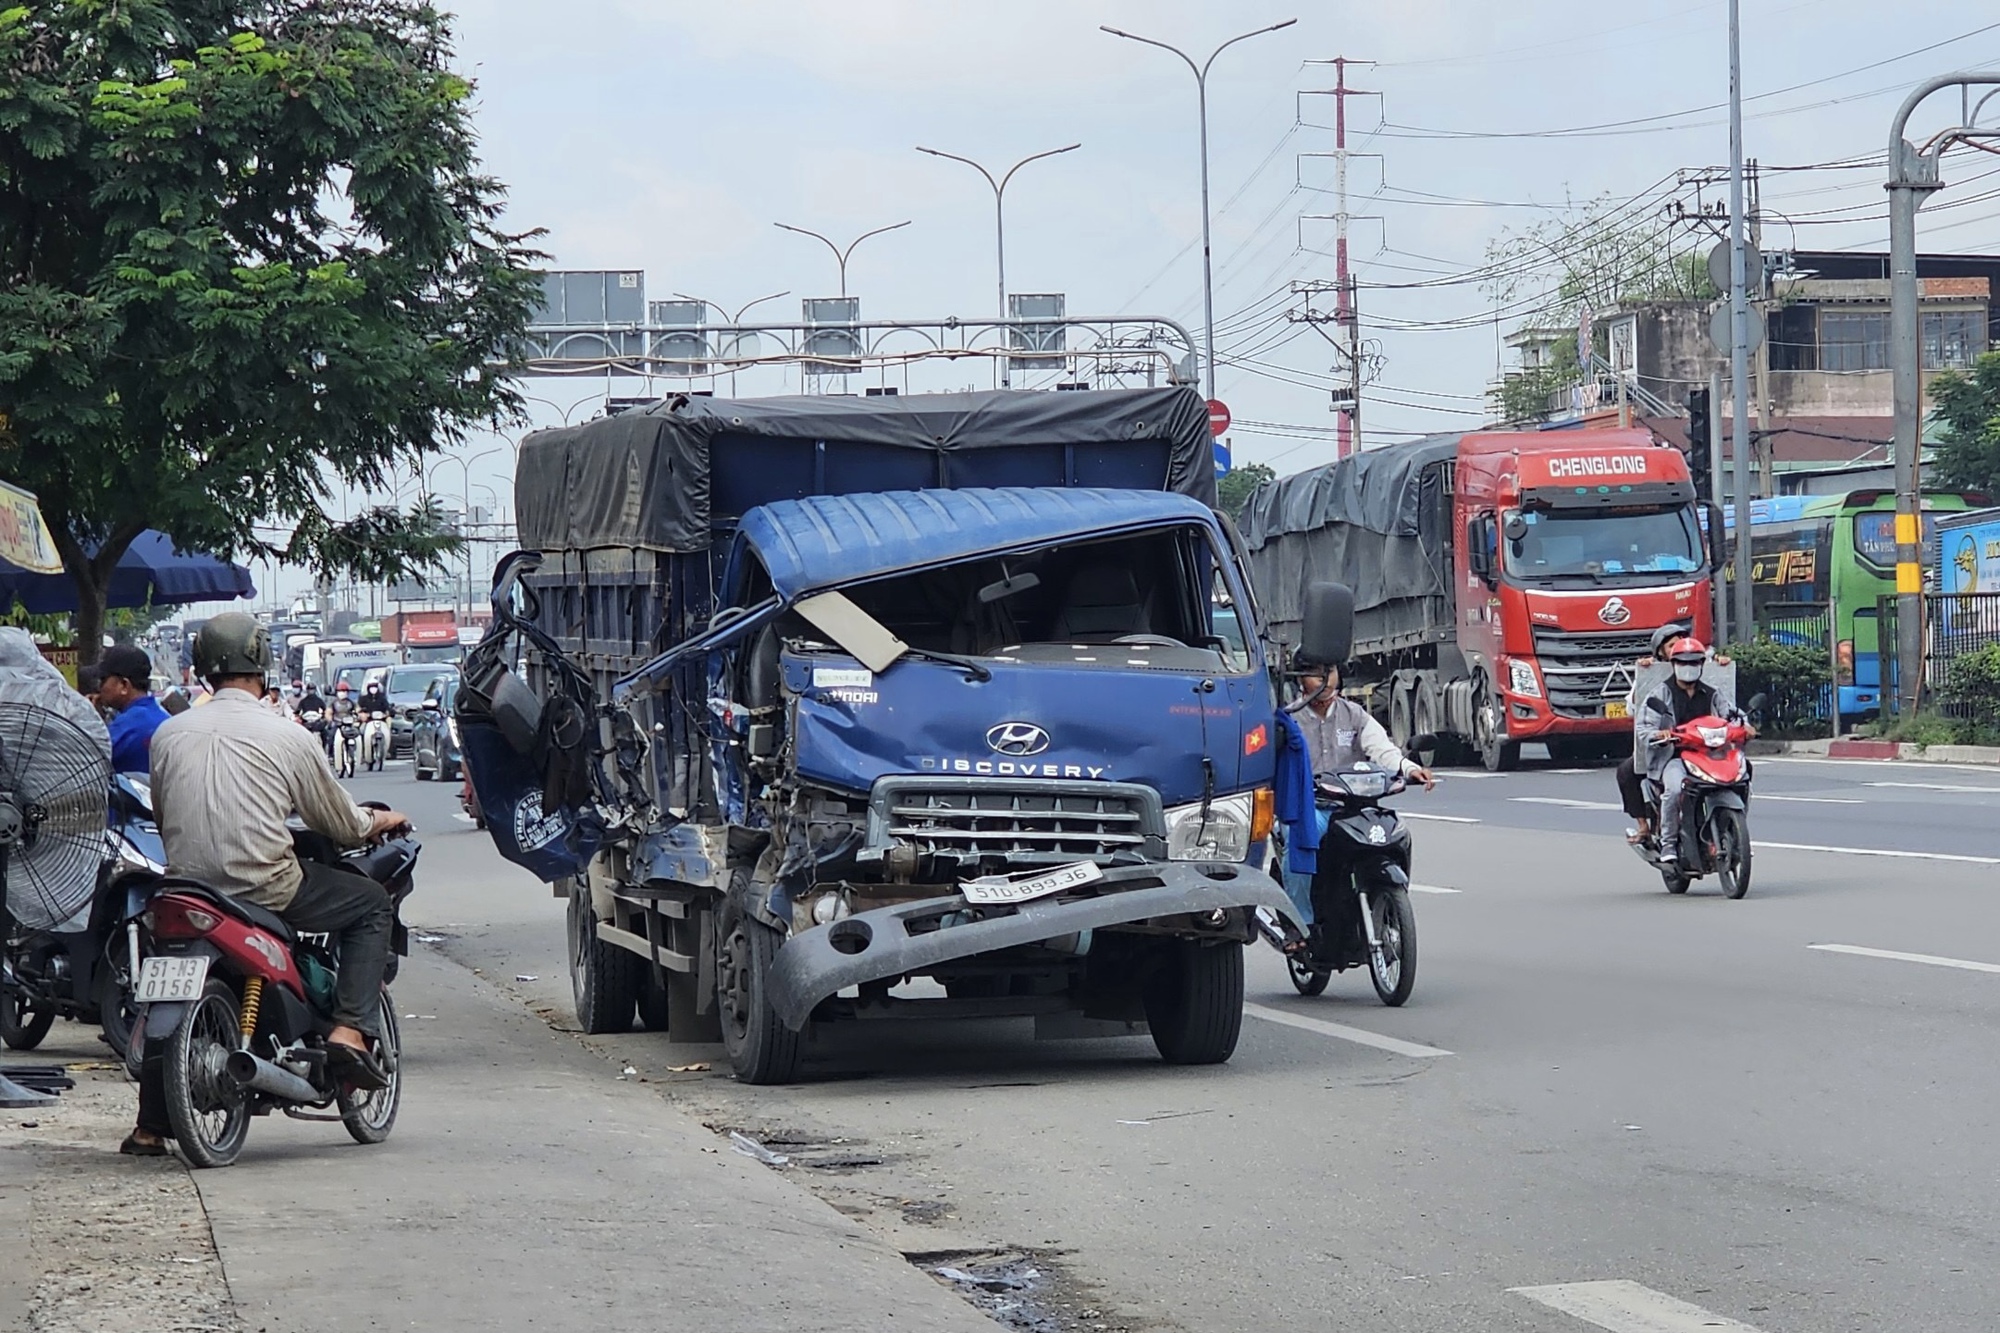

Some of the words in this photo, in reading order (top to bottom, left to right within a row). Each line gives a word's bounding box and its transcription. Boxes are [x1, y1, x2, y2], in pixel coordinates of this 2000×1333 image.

[1549, 456, 1646, 477] CHENGLONG
[975, 868, 1087, 898] 51D-899.36
[150, 960, 198, 978] 51-N3
[145, 979, 194, 997] 0156
